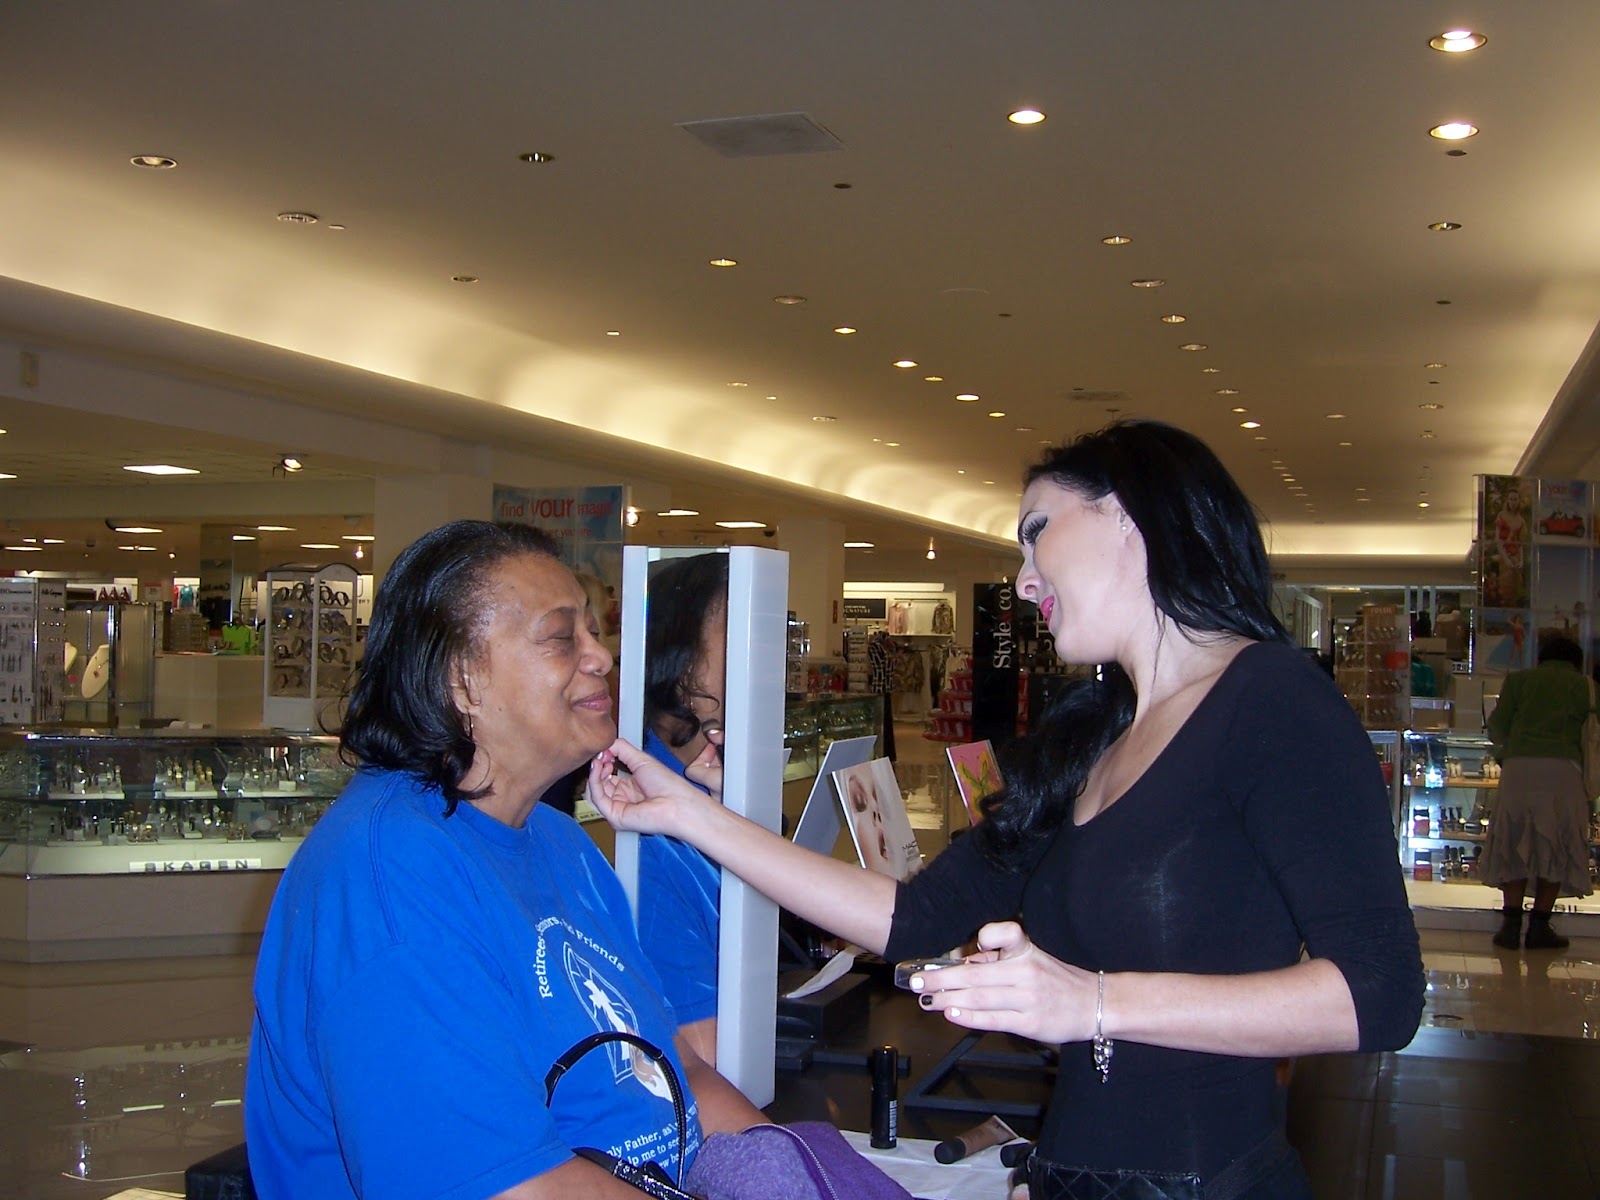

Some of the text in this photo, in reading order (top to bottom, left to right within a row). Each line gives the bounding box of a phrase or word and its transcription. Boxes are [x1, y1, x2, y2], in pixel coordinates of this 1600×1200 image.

[500, 502, 524, 517] find
[530, 497, 574, 523] your
[993, 622, 1016, 669] Style
[144, 858, 249, 873] SKAGEN
[624, 1131, 662, 1152] Father,
[641, 1149, 656, 1162] me
[656, 1143, 667, 1155] to
